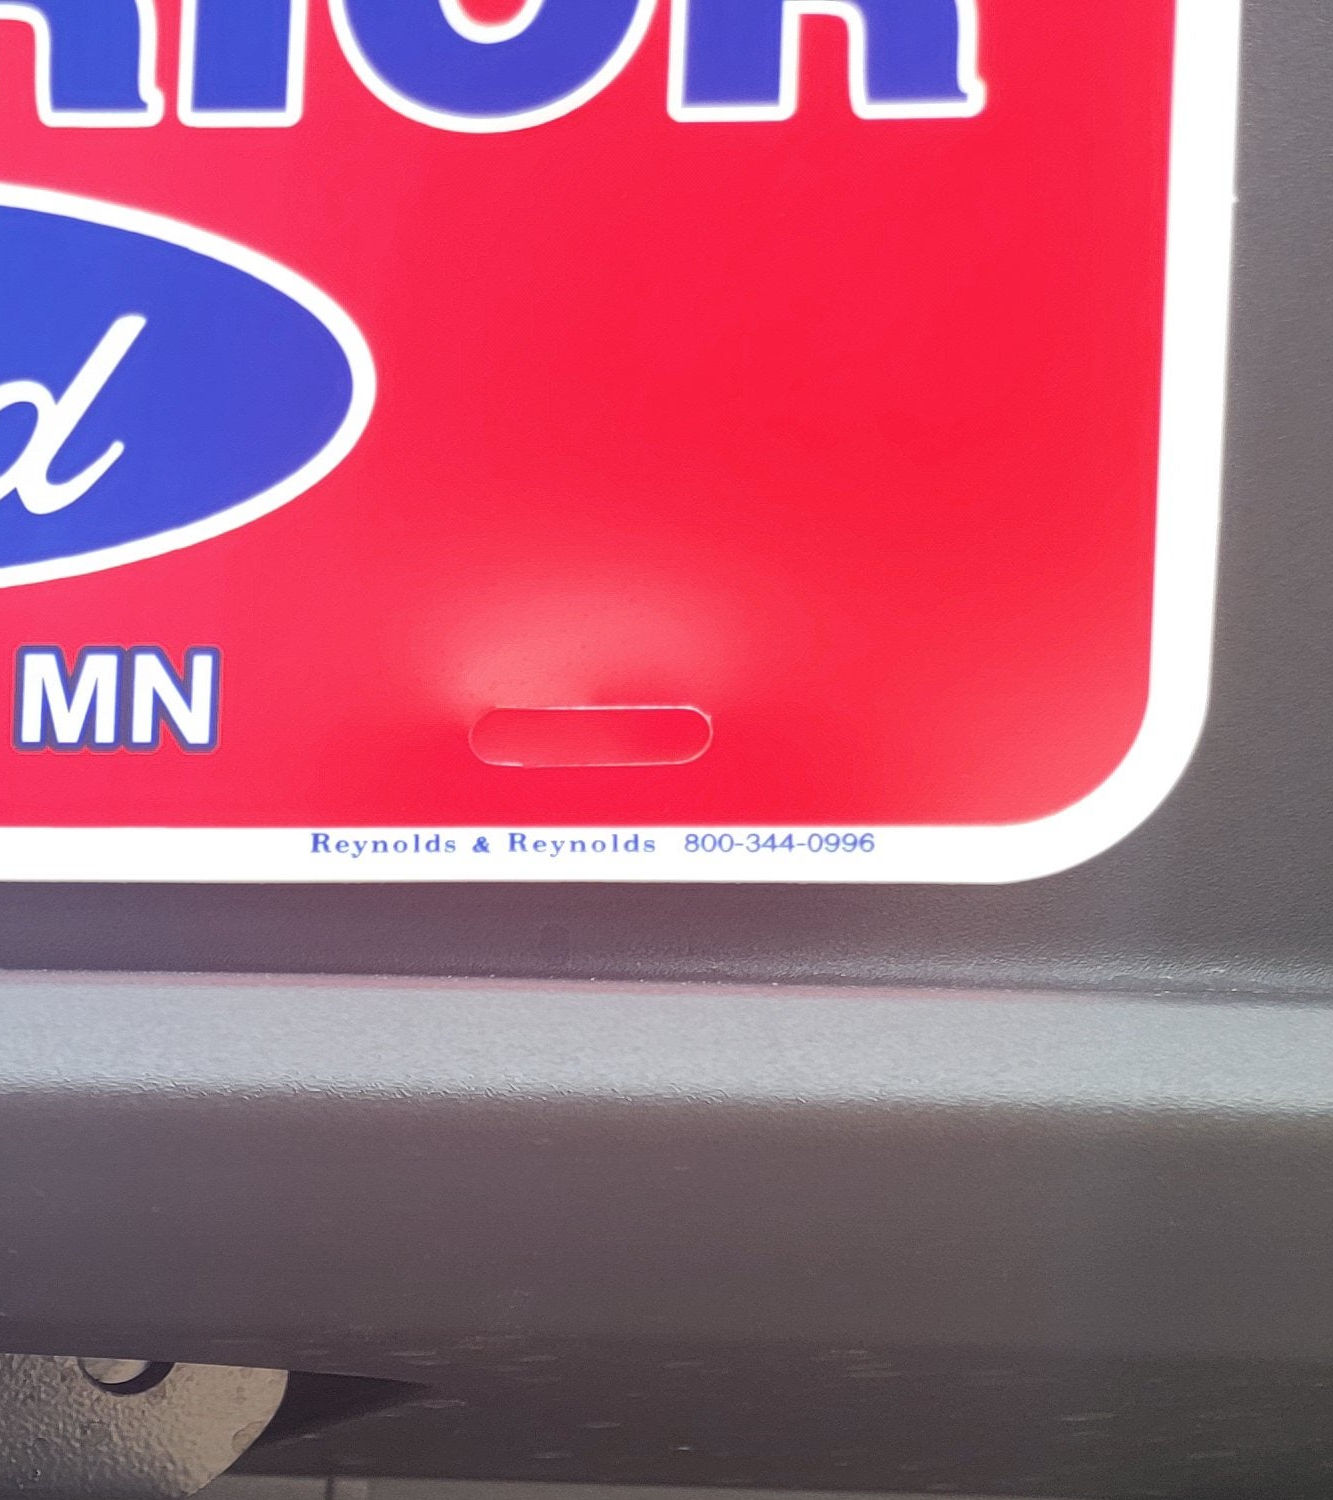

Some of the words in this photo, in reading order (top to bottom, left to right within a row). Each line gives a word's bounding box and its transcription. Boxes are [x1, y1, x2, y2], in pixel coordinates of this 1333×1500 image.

[14, 646, 219, 753] MN
[309, 831, 457, 858] Reynolds
[471, 834, 492, 854] &
[507, 831, 657, 858] Reynolds
[683, 832, 876, 854] 800-344-0996
